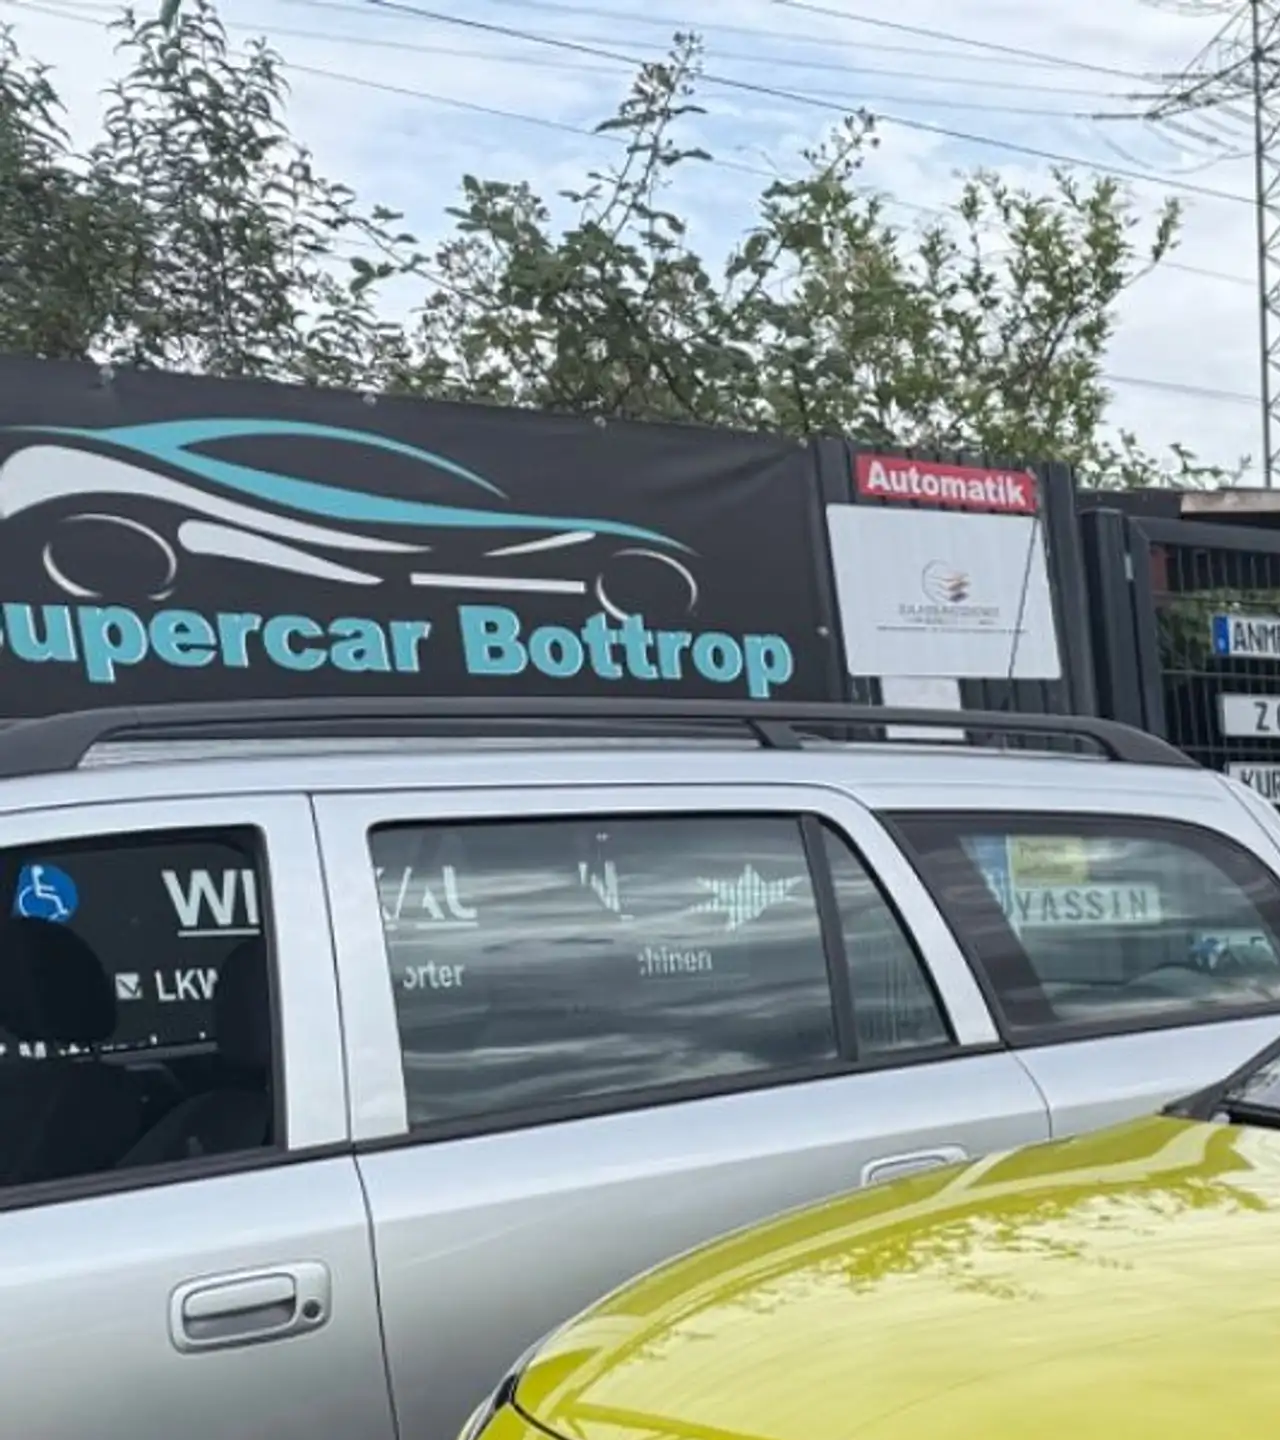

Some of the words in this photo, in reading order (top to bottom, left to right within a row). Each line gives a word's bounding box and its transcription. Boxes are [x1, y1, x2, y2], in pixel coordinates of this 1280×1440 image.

[867, 461, 1026, 506] Automatik
[0, 602, 433, 684] upercar
[457, 605, 795, 699] Bottrop
[1017, 886, 1149, 922] YASSIN
